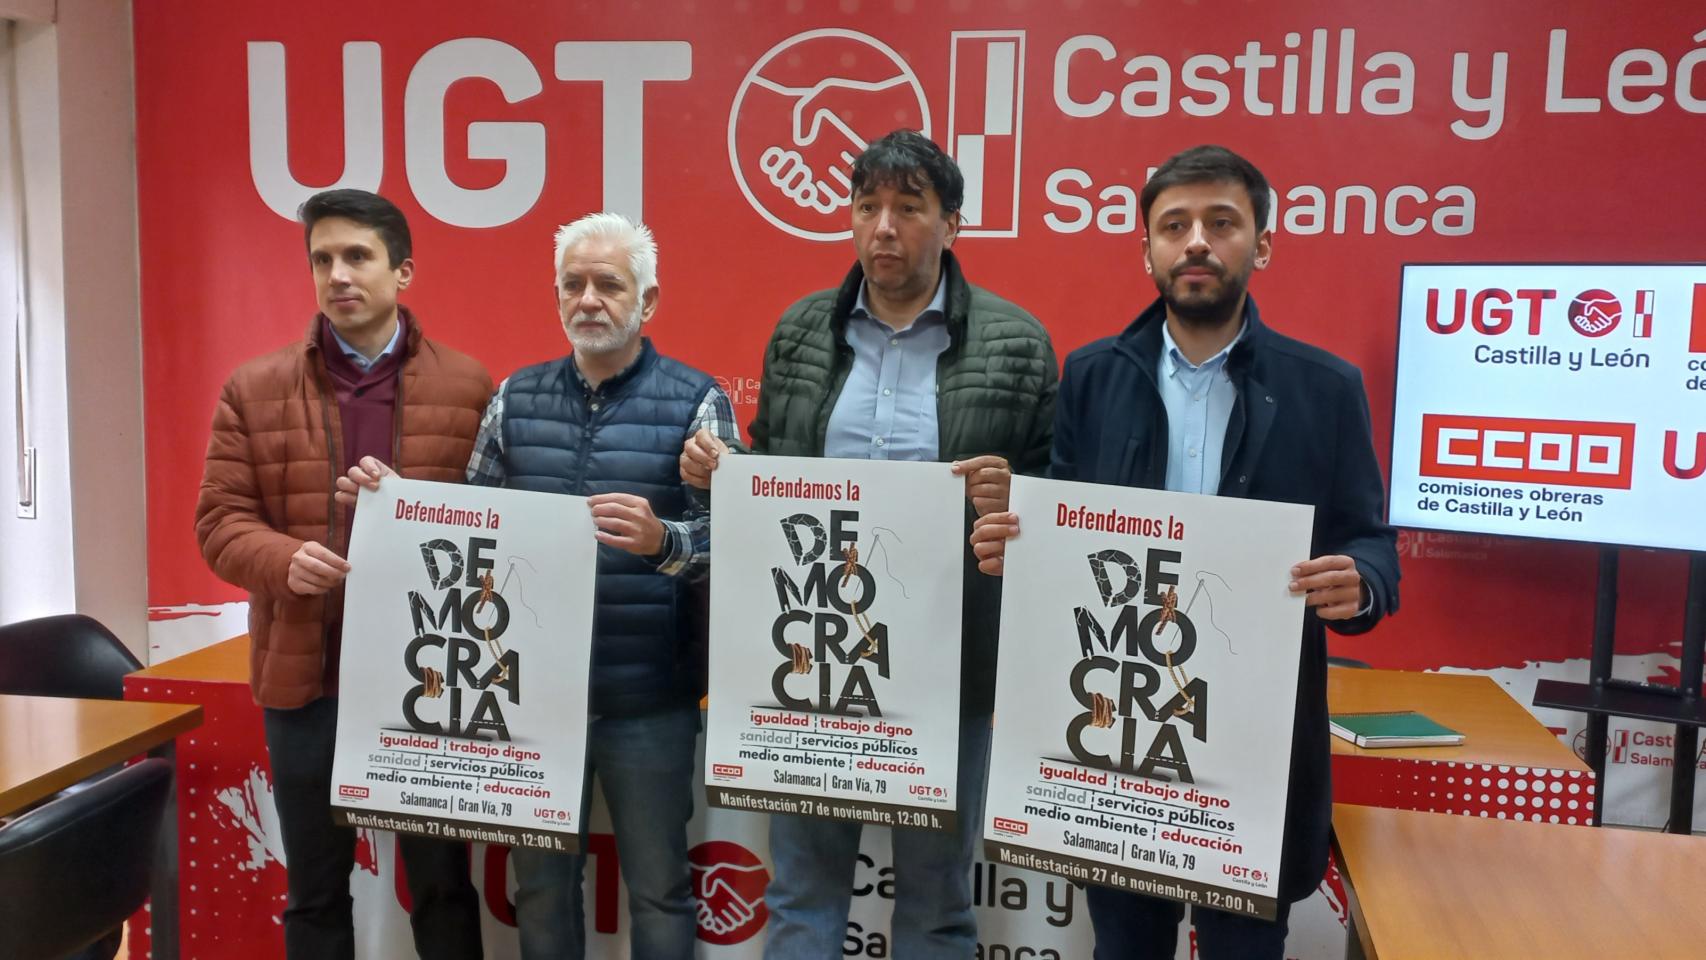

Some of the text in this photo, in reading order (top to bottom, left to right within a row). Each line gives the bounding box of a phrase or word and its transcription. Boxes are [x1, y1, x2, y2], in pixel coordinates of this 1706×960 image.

[1053, 28, 1415, 117] Castilla
[1451, 52, 1508, 140] y
[247, 37, 692, 228] UGT
[1043, 168, 1476, 235] Saanca
[1425, 288, 1557, 336] UGT
[1475, 344, 1651, 371] Castilla y León
[1436, 427, 1622, 475] CCOO
[752, 475, 860, 501] Defendamos la
[1418, 482, 1604, 505] comisiones obreras
[395, 498, 500, 529] Defendamos la
[1056, 503, 1184, 540] Defendamos la
[1417, 497, 1583, 522] de Castilla y León
[750, 710, 913, 737] igualdad trabajo digno
[380, 732, 541, 761] igualdad trabajo digno
[740, 731, 918, 756] sanidad servicios públicos
[368, 753, 545, 780] sanidad servicios públicos
[739, 749, 925, 775] medio ambiente educación
[366, 770, 551, 799] medio ambiente educación
[773, 770, 821, 787] Salamanca
[832, 775, 852, 790] Gran
[875, 780, 887, 794] 79
[909, 784, 931, 795] UGT
[1040, 761, 1230, 808] igualdad trabajo digno
[400, 791, 448, 809] Salamanca
[458, 797, 479, 813] Gran
[501, 803, 512, 816] 79
[534, 808, 556, 818] UGT
[720, 792, 942, 830] Manifestación 27 de noviembre, 12:00 h.
[1026, 785, 1235, 831] sanidad servicios públicos
[346, 812, 565, 851] Manifestación 27 de noviembre, 12:00 h.
[995, 819, 1027, 833] CCOO
[1025, 805, 1242, 854] medio ambiente educación
[1063, 830, 1196, 870] Salamanca Gran Vía, 79
[1000, 848, 1259, 914] Manifestación 27 de noviembre, 12:00 h.
[1222, 863, 1250, 878] UGT
[1046, 880, 1074, 928] y
